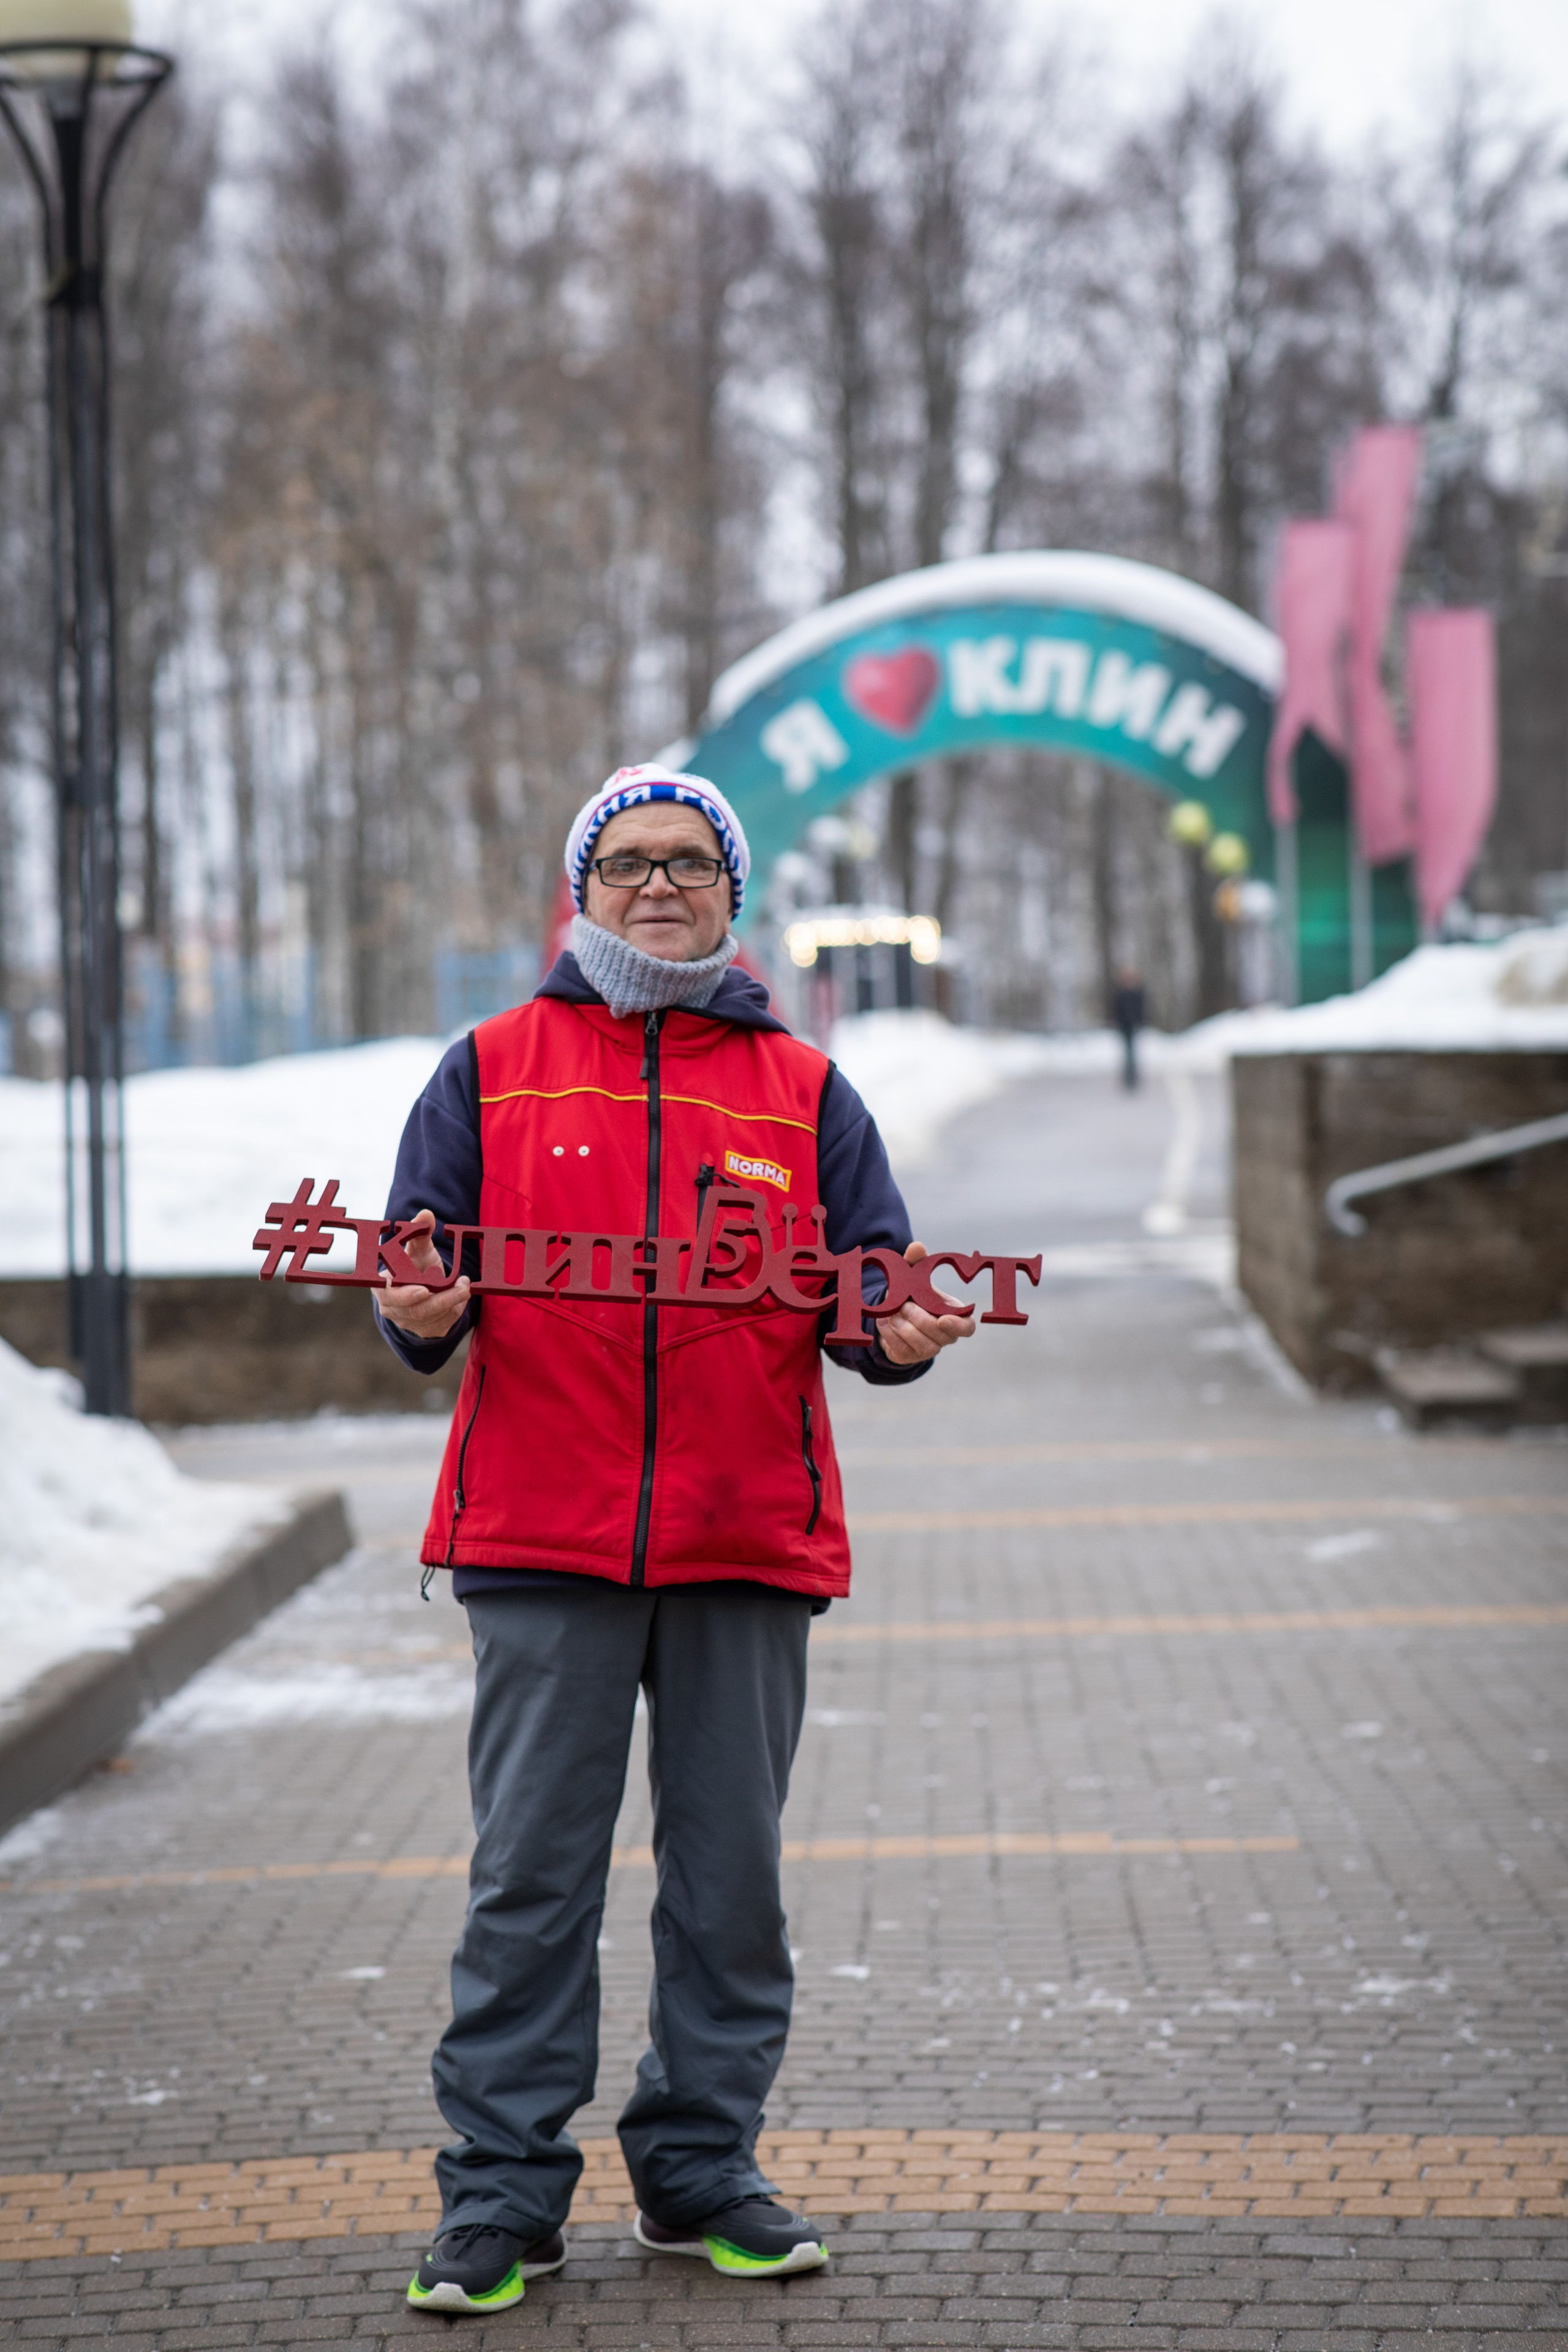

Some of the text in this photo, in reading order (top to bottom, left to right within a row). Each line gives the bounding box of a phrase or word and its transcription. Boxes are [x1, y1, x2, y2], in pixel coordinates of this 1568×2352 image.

[760, 633, 1246, 794] Я КЛИН
[729, 1155, 786, 1186] NORMA
